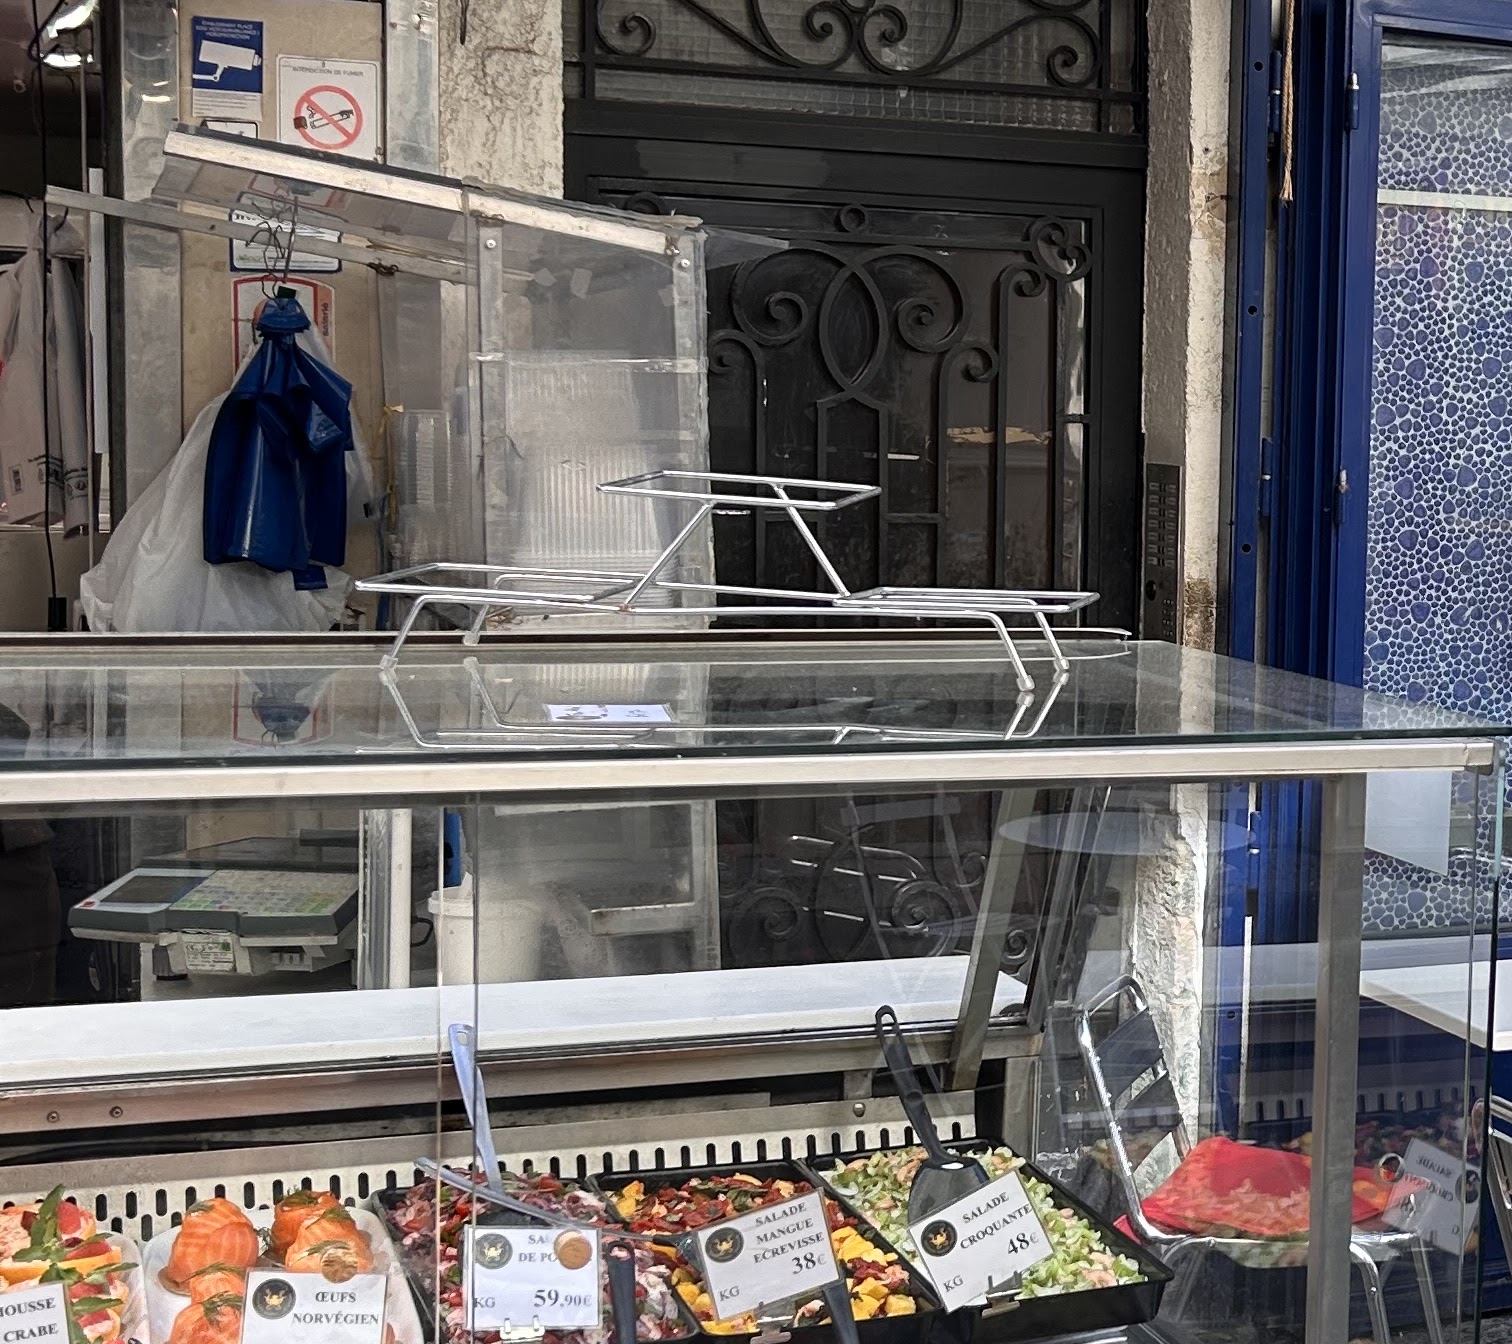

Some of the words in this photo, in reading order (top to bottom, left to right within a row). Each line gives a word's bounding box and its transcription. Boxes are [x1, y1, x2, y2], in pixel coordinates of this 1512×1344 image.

[755, 1202, 807, 1227] SALADE
[962, 1191, 1010, 1224] SALADE
[757, 1218, 814, 1245] MANGUE
[960, 1203, 1033, 1250] CROQUANTE
[518, 1253, 537, 1262] DE
[753, 1232, 825, 1264] ECREVISSE
[719, 1286, 740, 1301] KG
[943, 1275, 964, 1293] KG
[474, 1297, 496, 1308] KG
[292, 1311, 379, 1324] NORVÉGIEN
[3, 1323, 58, 1343] CRABE
